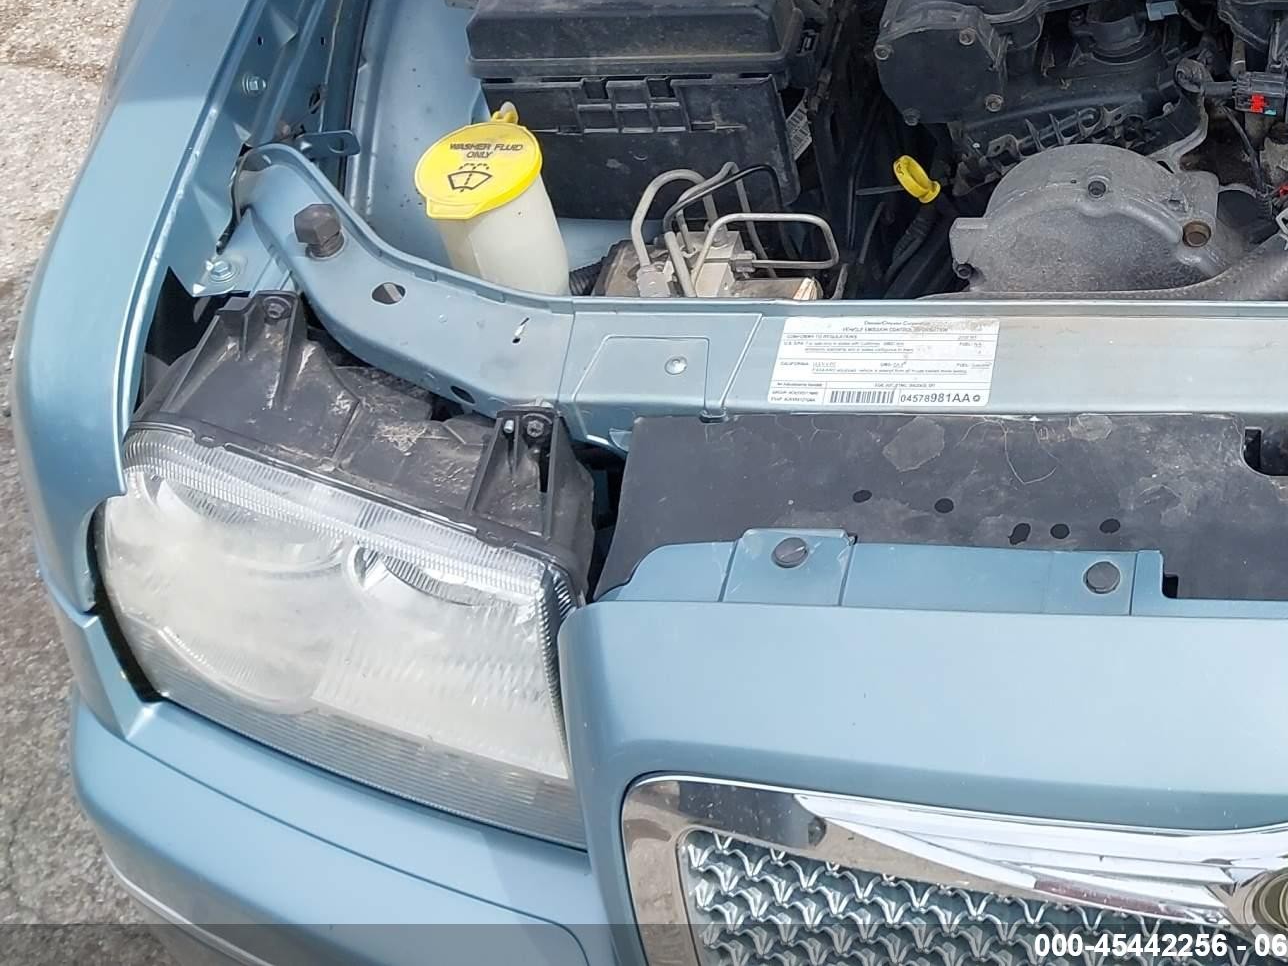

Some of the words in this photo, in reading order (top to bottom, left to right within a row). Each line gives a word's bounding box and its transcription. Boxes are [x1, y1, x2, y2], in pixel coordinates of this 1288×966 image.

[494, 143, 524, 151] FLUID
[466, 151, 493, 159] ONLY
[900, 392, 971, 404] 04578981AA
